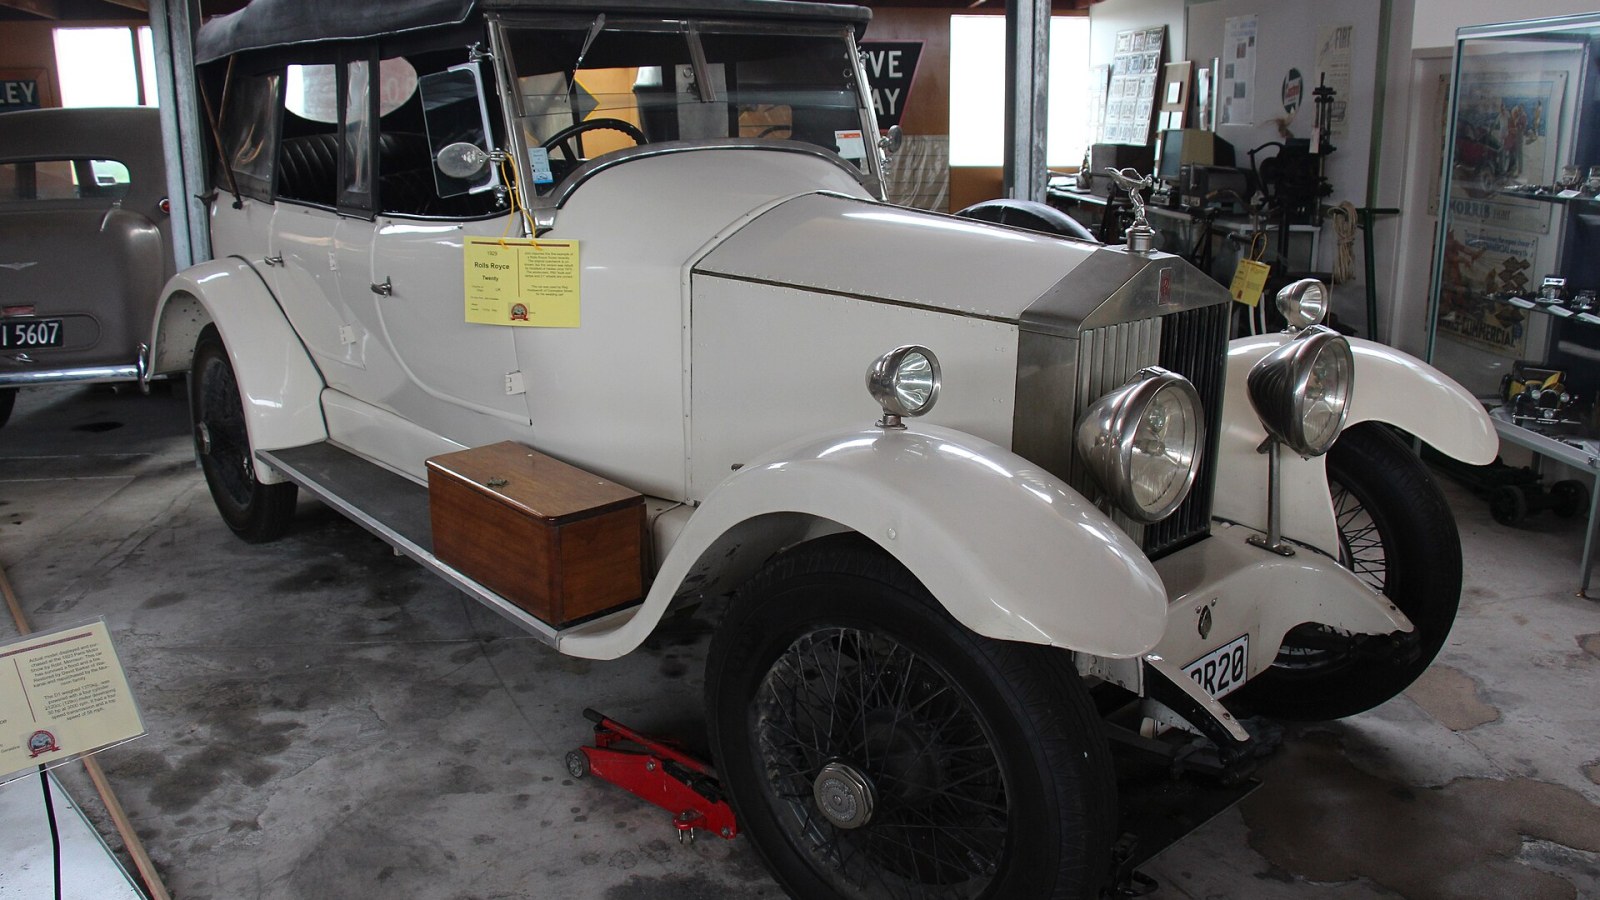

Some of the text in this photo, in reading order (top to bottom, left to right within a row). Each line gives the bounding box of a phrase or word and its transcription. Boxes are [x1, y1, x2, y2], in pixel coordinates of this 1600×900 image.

[474, 261, 510, 270] Rolls Royce
[15, 322, 59, 345] 5607
